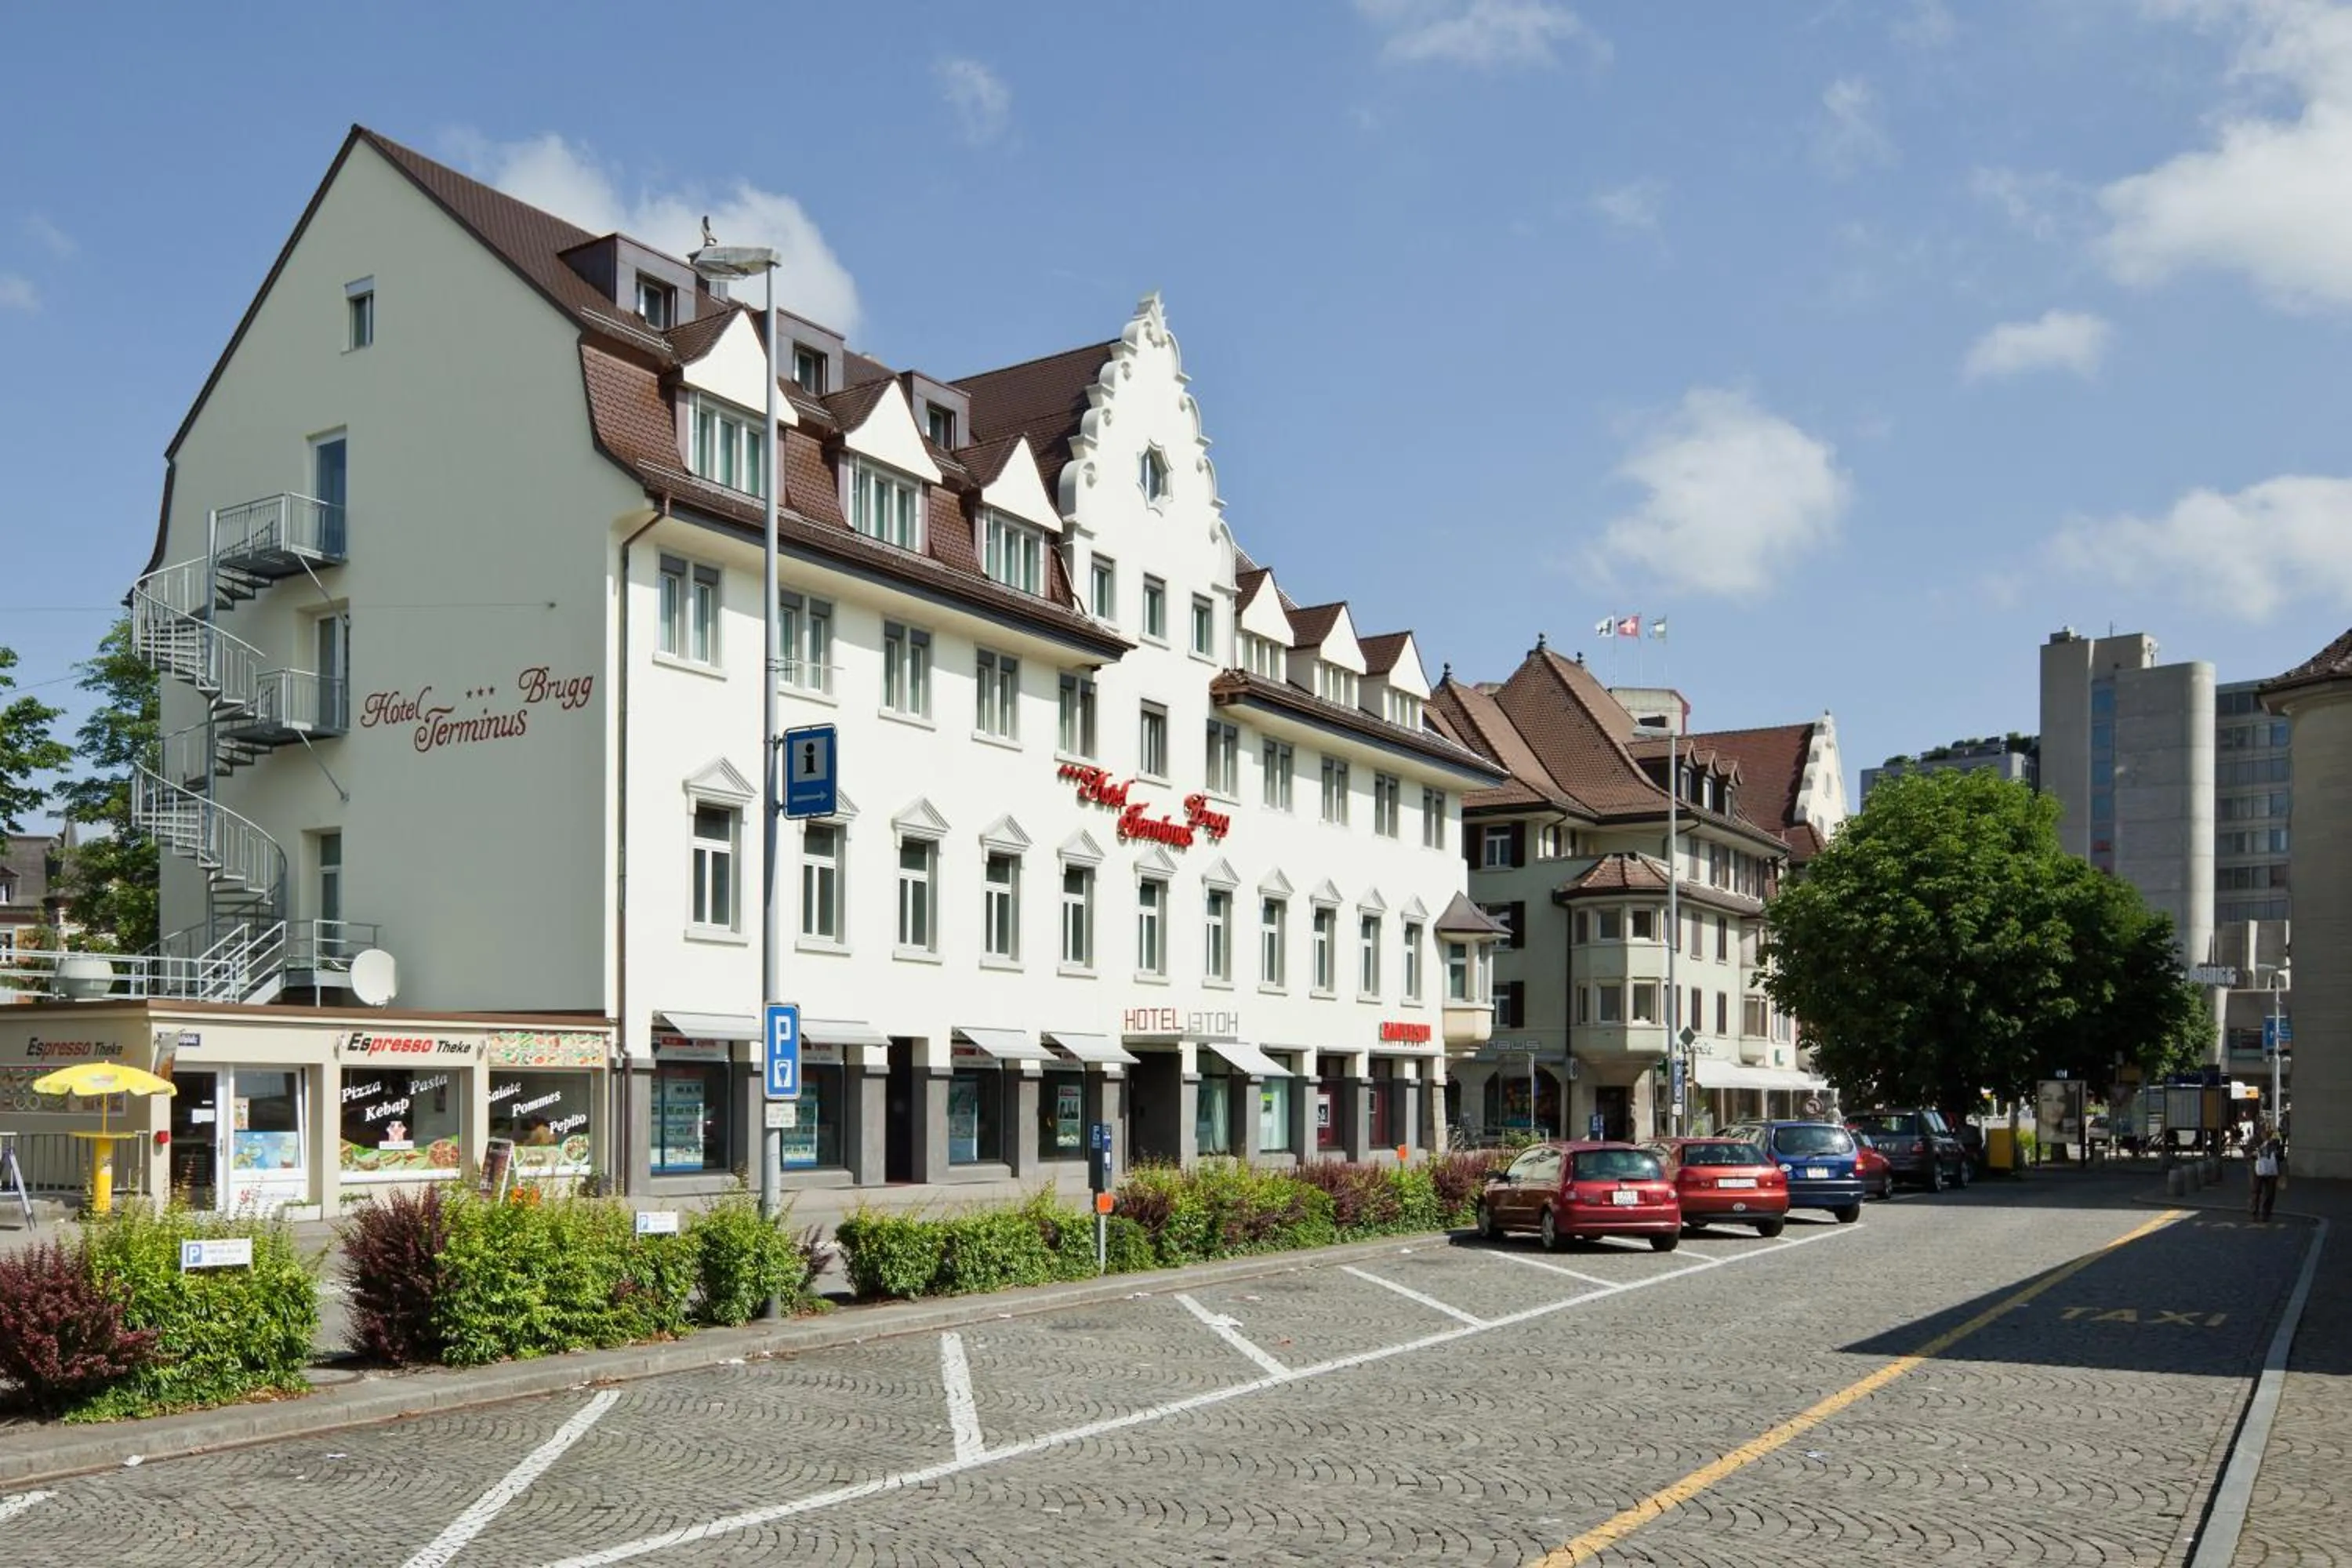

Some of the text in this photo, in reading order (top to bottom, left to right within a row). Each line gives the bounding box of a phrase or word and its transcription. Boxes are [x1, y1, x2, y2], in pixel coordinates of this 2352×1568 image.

[518, 667, 594, 710] Brugg
[360, 686, 432, 728] Hotel
[414, 706, 528, 753] Terminus
[1077, 765, 1136, 808] Hotel
[1116, 802, 1196, 848] Terminus
[1184, 793, 1230, 839] Brugg
[1125, 1007, 1184, 1030] HOTEL
[347, 1033, 471, 1056] Espresso Theke
[775, 1016, 791, 1054] P
[27, 1037, 123, 1060] Espresso Theke
[342, 1080, 382, 1103] Pizza
[410, 1074, 448, 1095] Pasta
[365, 1098, 410, 1121] Kebap
[512, 1090, 561, 1117] Pommes
[550, 1113, 587, 1134] Pepito
[2060, 1306, 2227, 1327] TAXI
